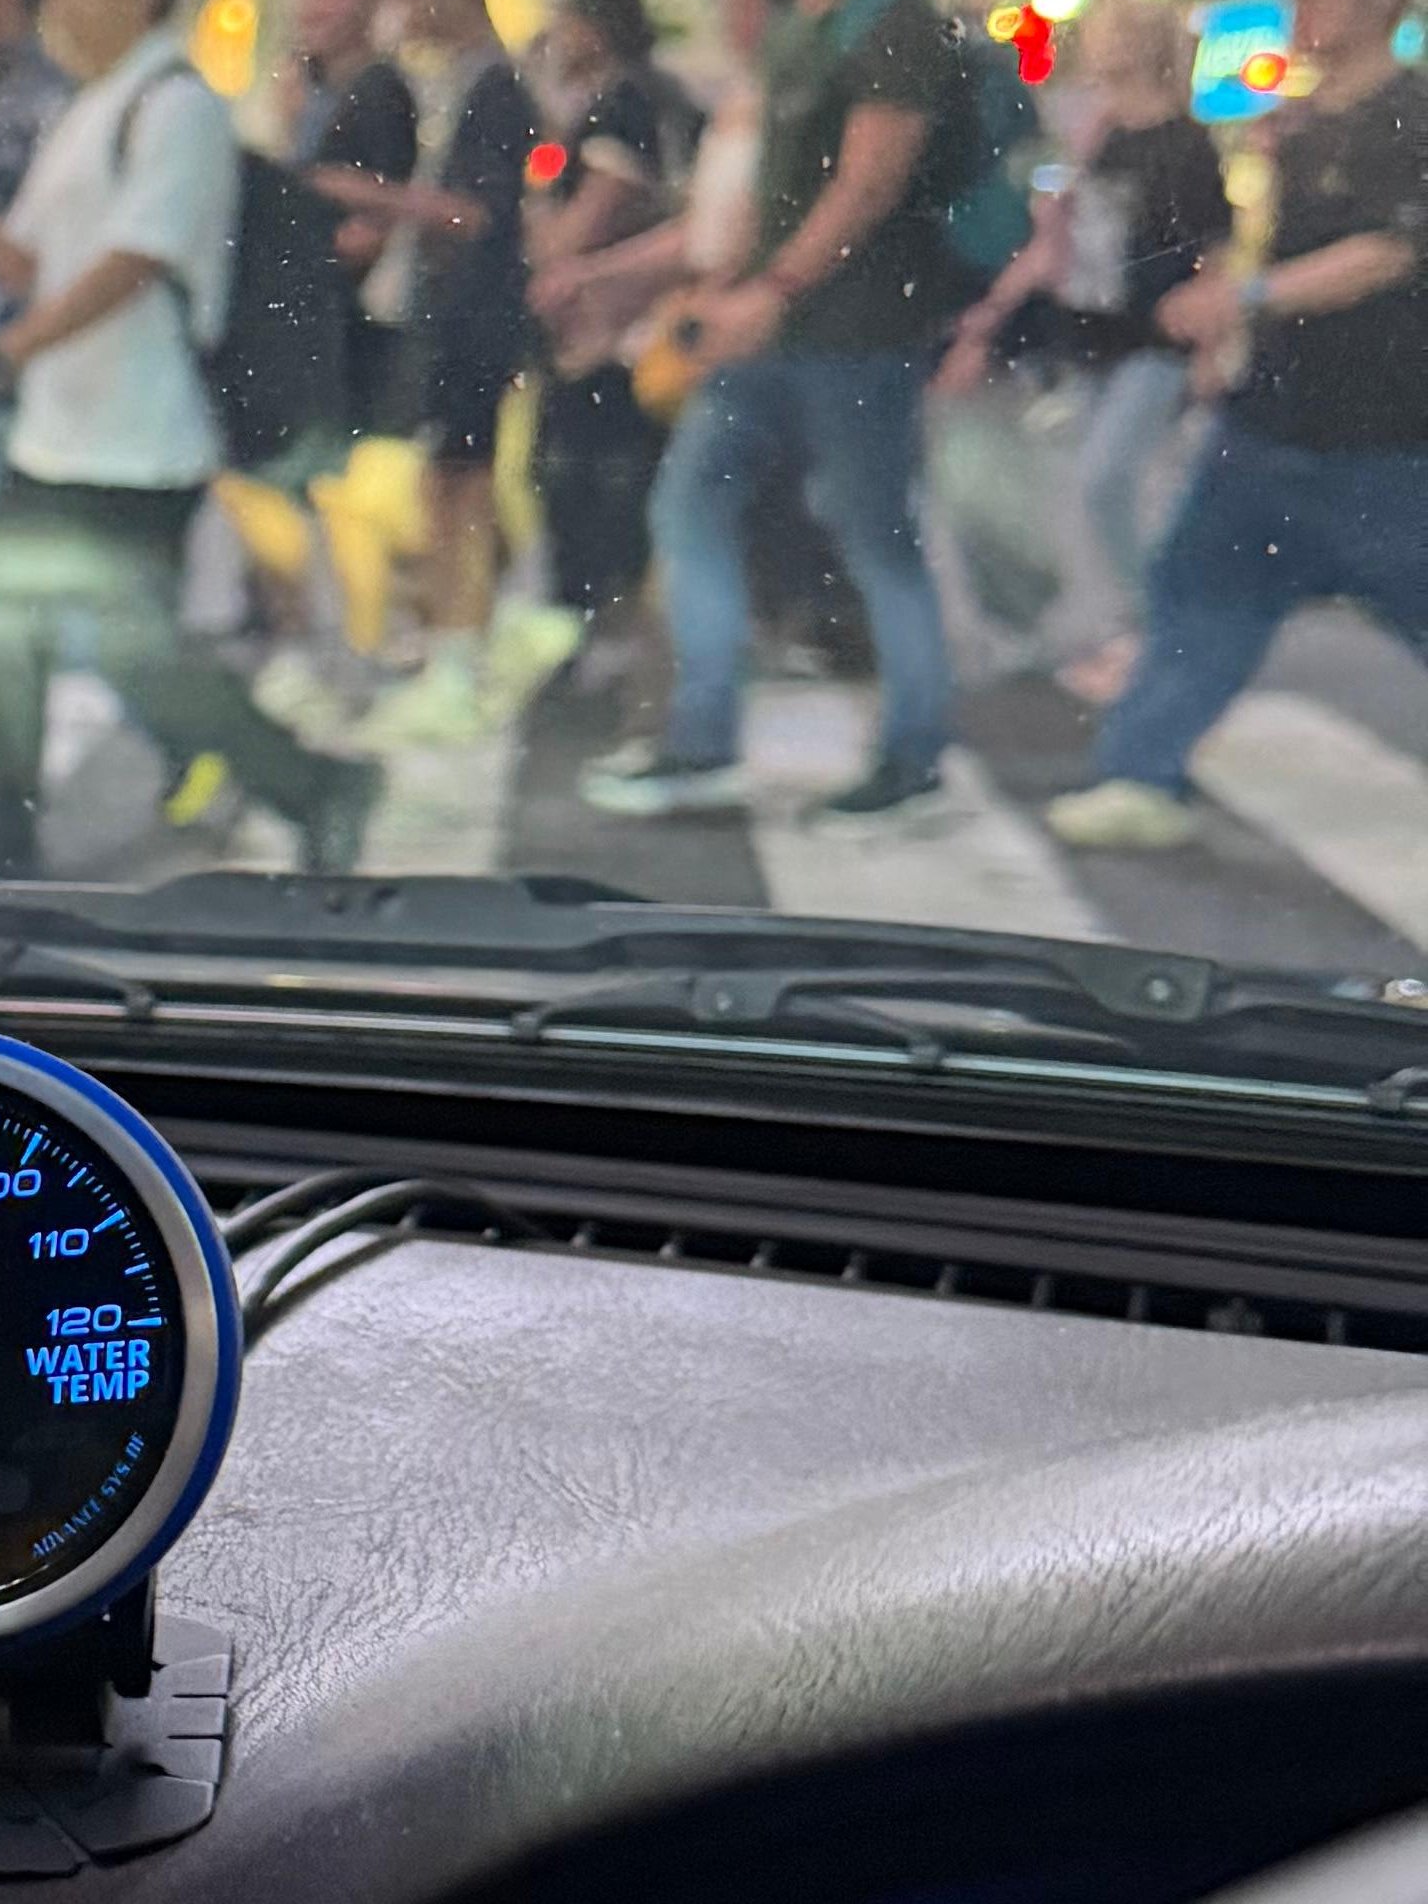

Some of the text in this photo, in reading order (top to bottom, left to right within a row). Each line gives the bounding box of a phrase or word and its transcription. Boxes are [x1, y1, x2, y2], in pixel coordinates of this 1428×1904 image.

[29, 1229, 90, 1260] 110
[45, 1305, 122, 1336] 120
[26, 1338, 151, 1377] WATER
[47, 1369, 150, 1405] TEMP
